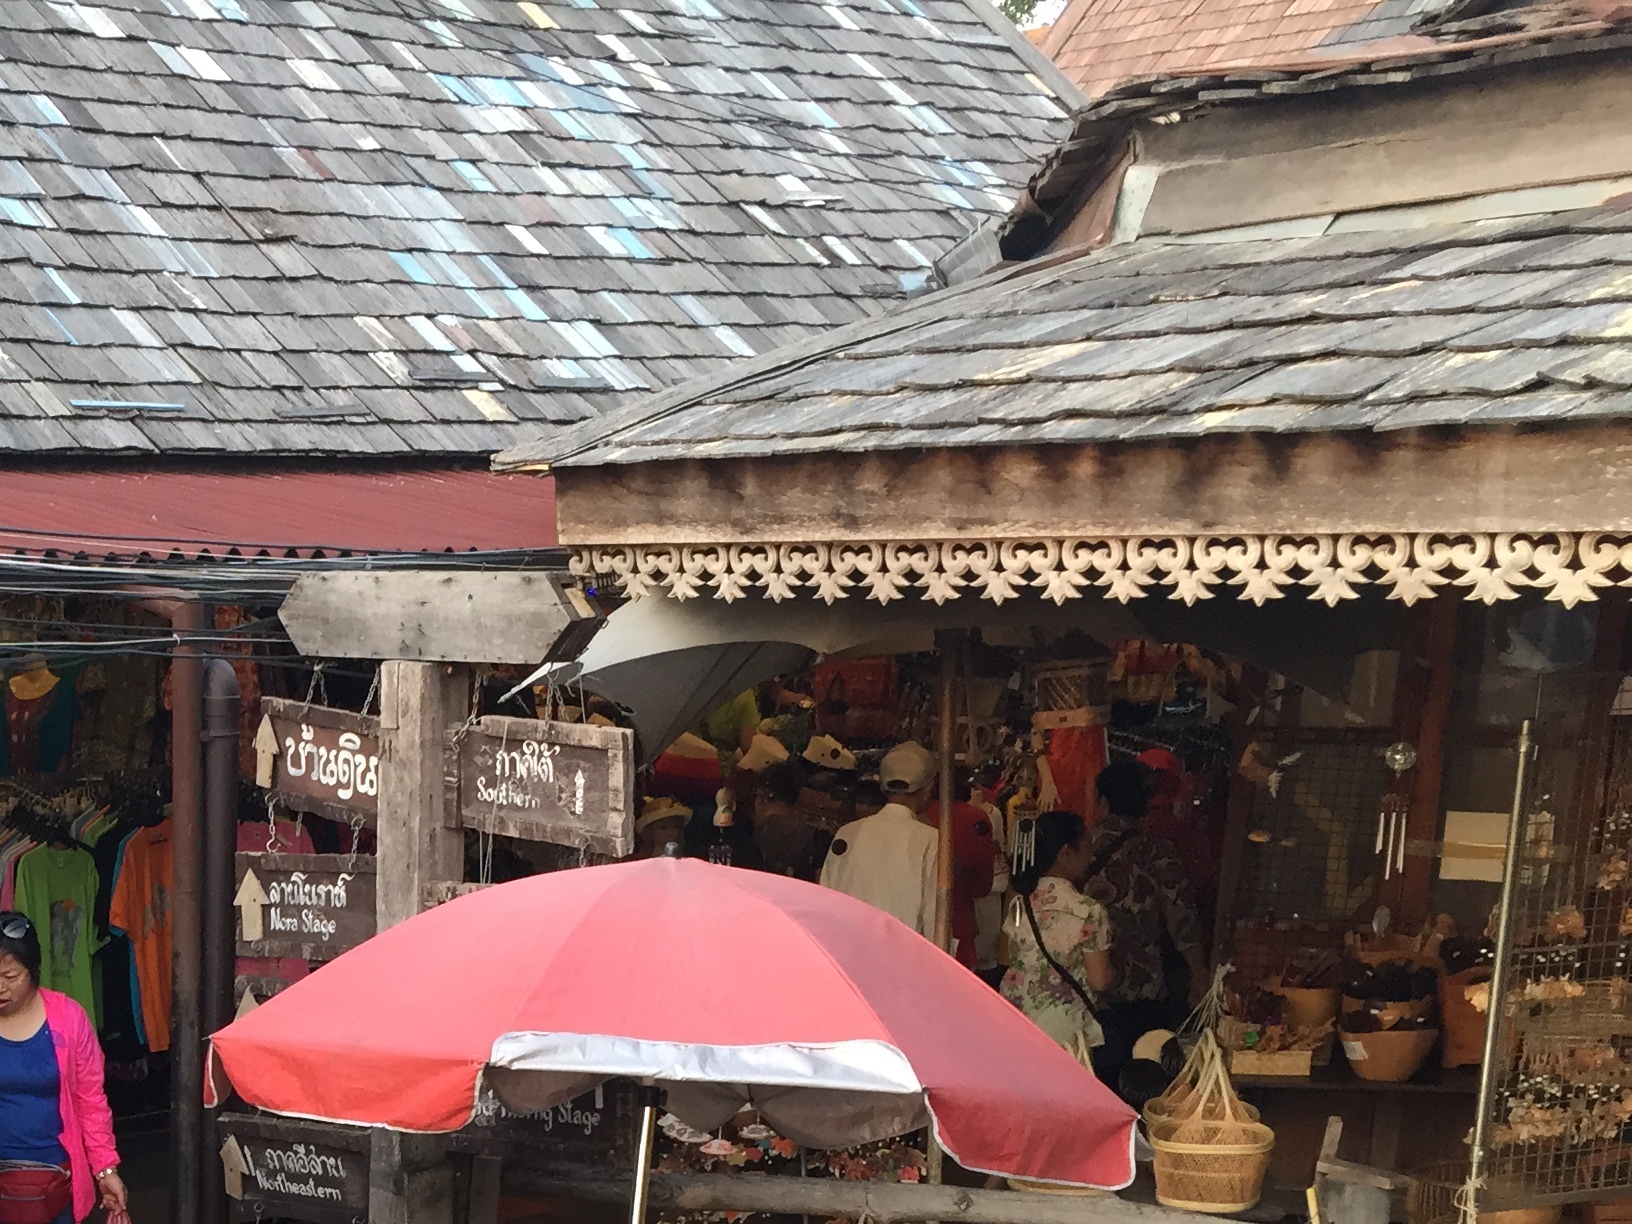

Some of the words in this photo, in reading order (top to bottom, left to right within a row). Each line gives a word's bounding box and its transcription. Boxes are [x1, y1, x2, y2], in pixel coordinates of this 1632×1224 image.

[285, 724, 378, 800] บ้านดิน
[495, 740, 561, 783] ภาคใต้
[476, 775, 541, 809] Southern
[268, 871, 356, 908] ลานโนราห์
[270, 906, 298, 931] Nora
[301, 908, 337, 942] Stage
[256, 1169, 342, 1202] Northeastern
